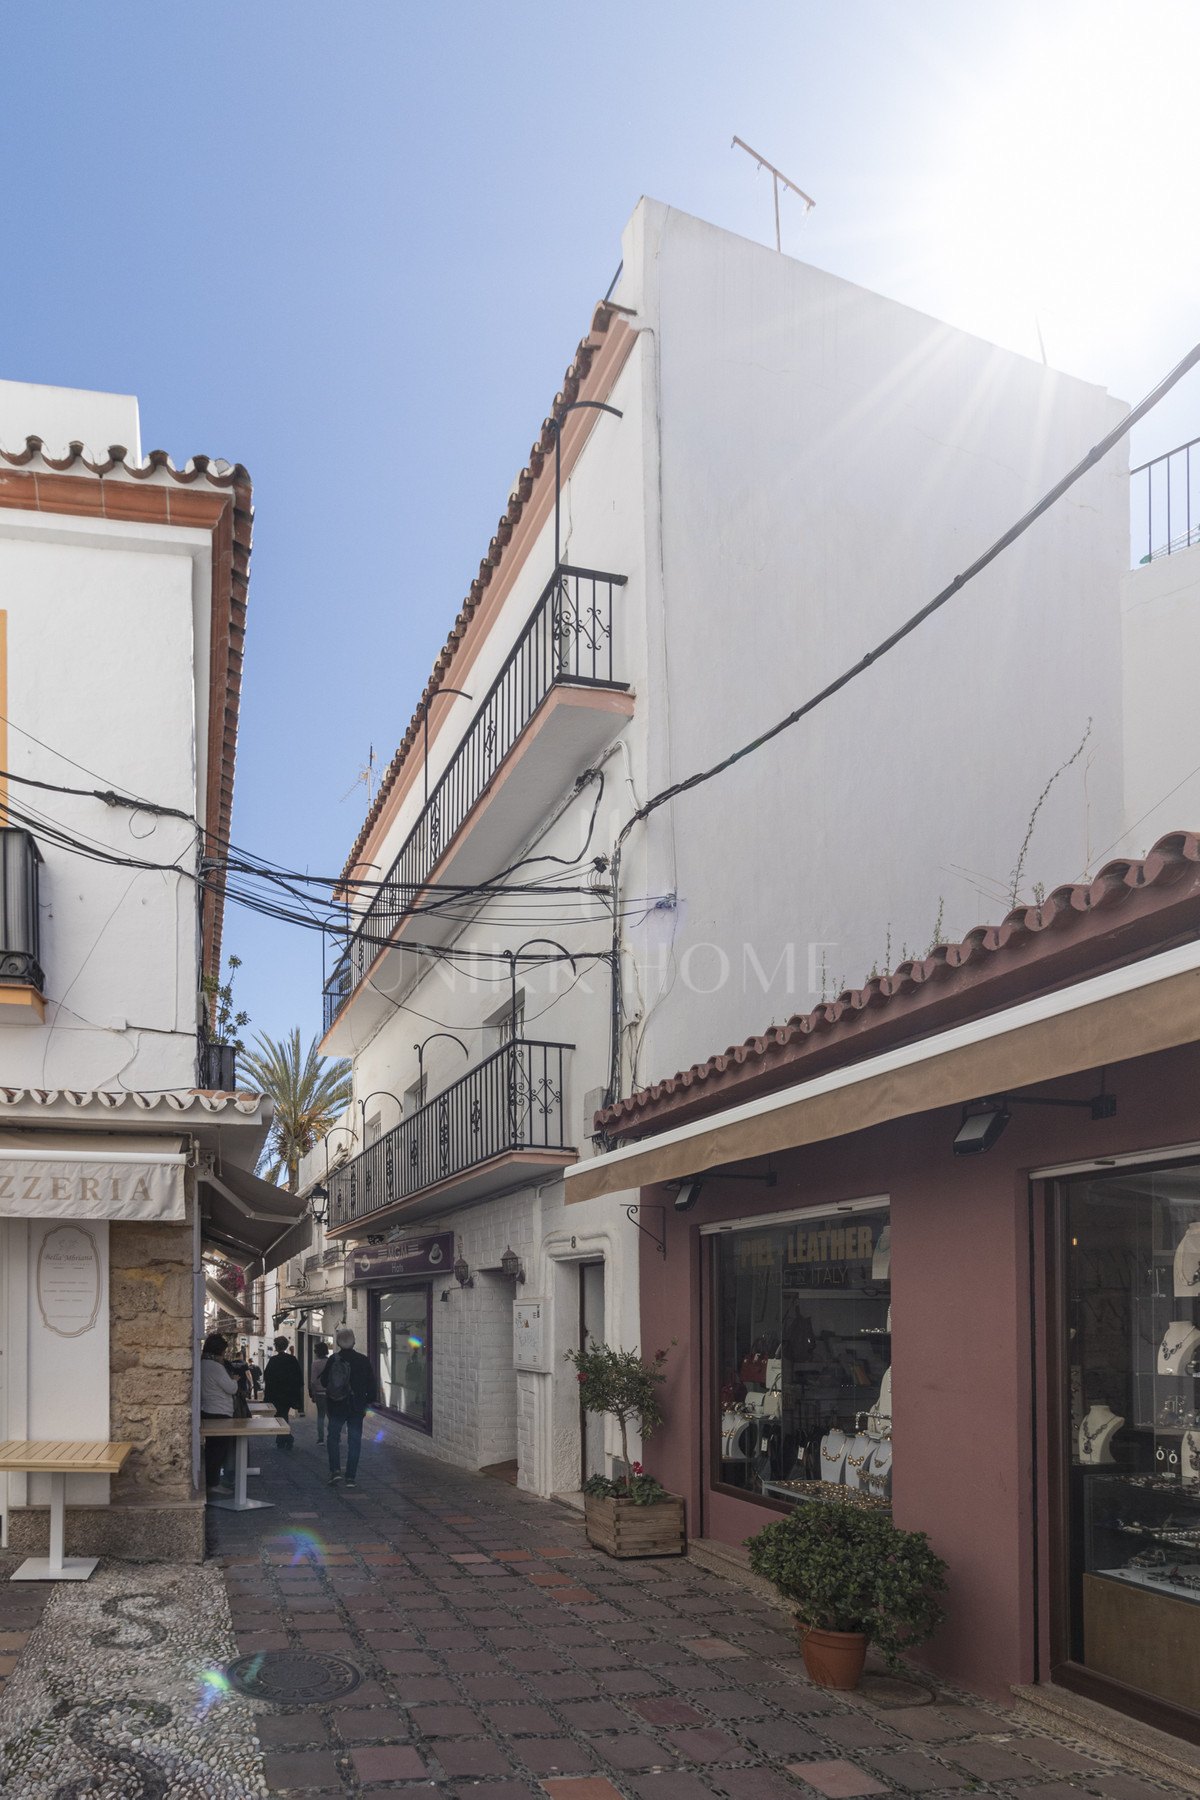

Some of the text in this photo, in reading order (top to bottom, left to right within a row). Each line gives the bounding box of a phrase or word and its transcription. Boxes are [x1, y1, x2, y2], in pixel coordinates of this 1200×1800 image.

[0, 1175, 153, 1201] ZZERIA
[386, 1243, 409, 1259] MGM
[571, 1235, 576, 1249] 8
[787, 1226, 873, 1264] LEATHER
[811, 1265, 849, 1285] ITALY
